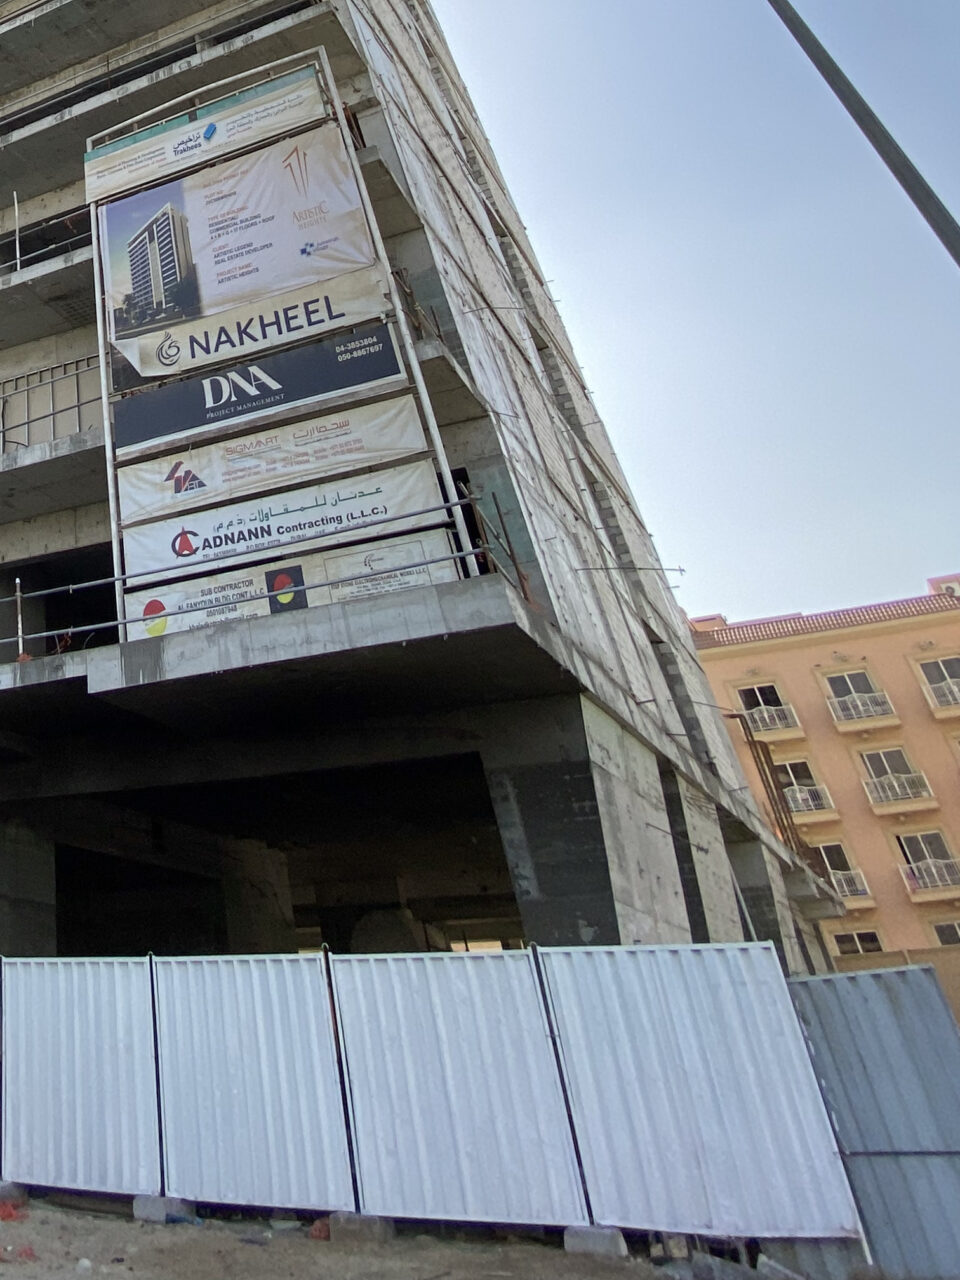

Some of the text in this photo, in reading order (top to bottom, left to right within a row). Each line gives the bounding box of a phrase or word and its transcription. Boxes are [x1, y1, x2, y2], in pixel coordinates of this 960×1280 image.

[173, 141, 202, 157] Trakhees
[239, 213, 261, 225] BUILDING
[293, 200, 329, 224] ARTISTIC
[214, 242, 253, 258] ARTISTIC LEGEND
[214, 242, 273, 265] REAL ESTATE DEVELOPER
[218, 267, 259, 285] ARTISTIC HEIGHTS
[189, 295, 346, 359] NAKHEEL
[201, 365, 283, 409] DNA
[206, 393, 285, 419] PROJECT MANAGEMENT
[201, 524, 272, 551] ADNANN
[276, 513, 343, 536] Contracting
[346, 505, 388, 522] (L.L.C.)
[200, 579, 254, 597] SUB CONTRACTOR
